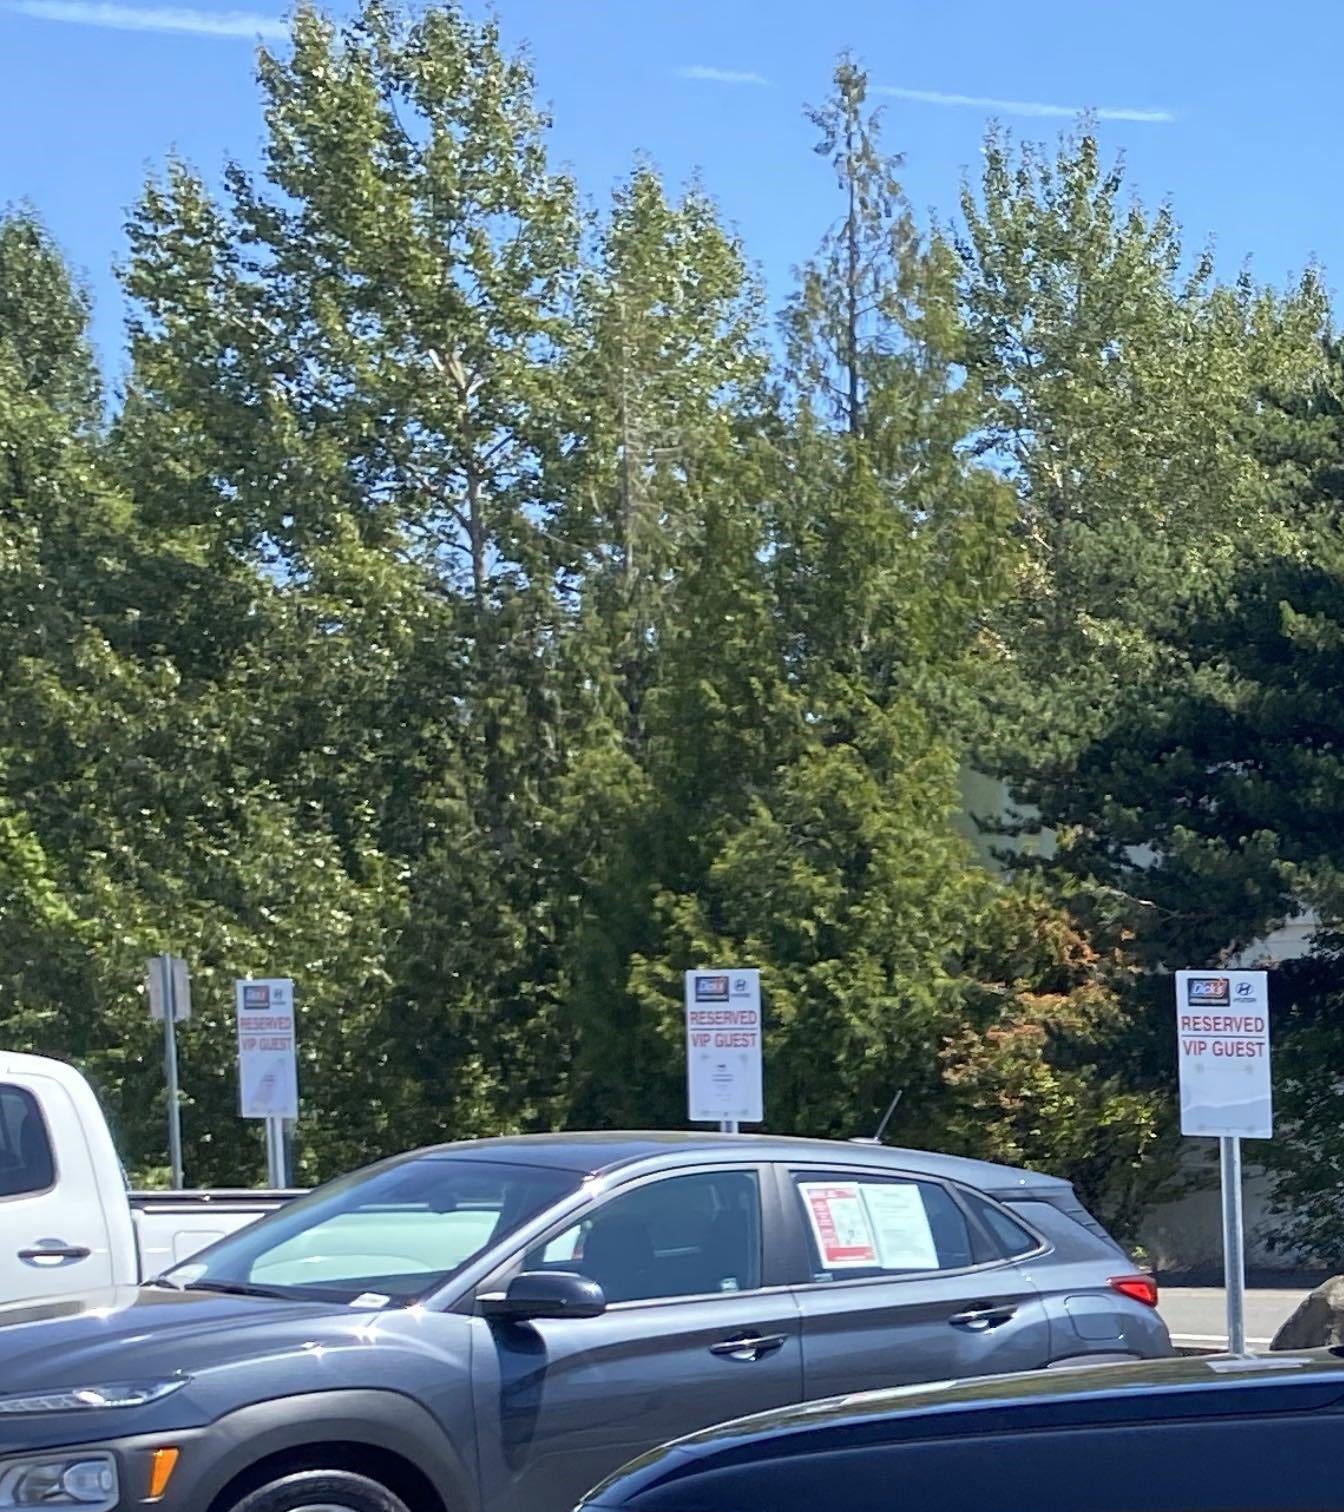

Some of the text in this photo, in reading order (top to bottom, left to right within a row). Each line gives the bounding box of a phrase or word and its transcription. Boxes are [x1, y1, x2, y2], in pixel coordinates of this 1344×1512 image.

[689, 1010, 758, 1025] RESERVED
[1181, 1015, 1265, 1033] RESERVED
[691, 1032, 757, 1048] VIP GUEST
[1183, 1039, 1265, 1058] VIP GUEST
